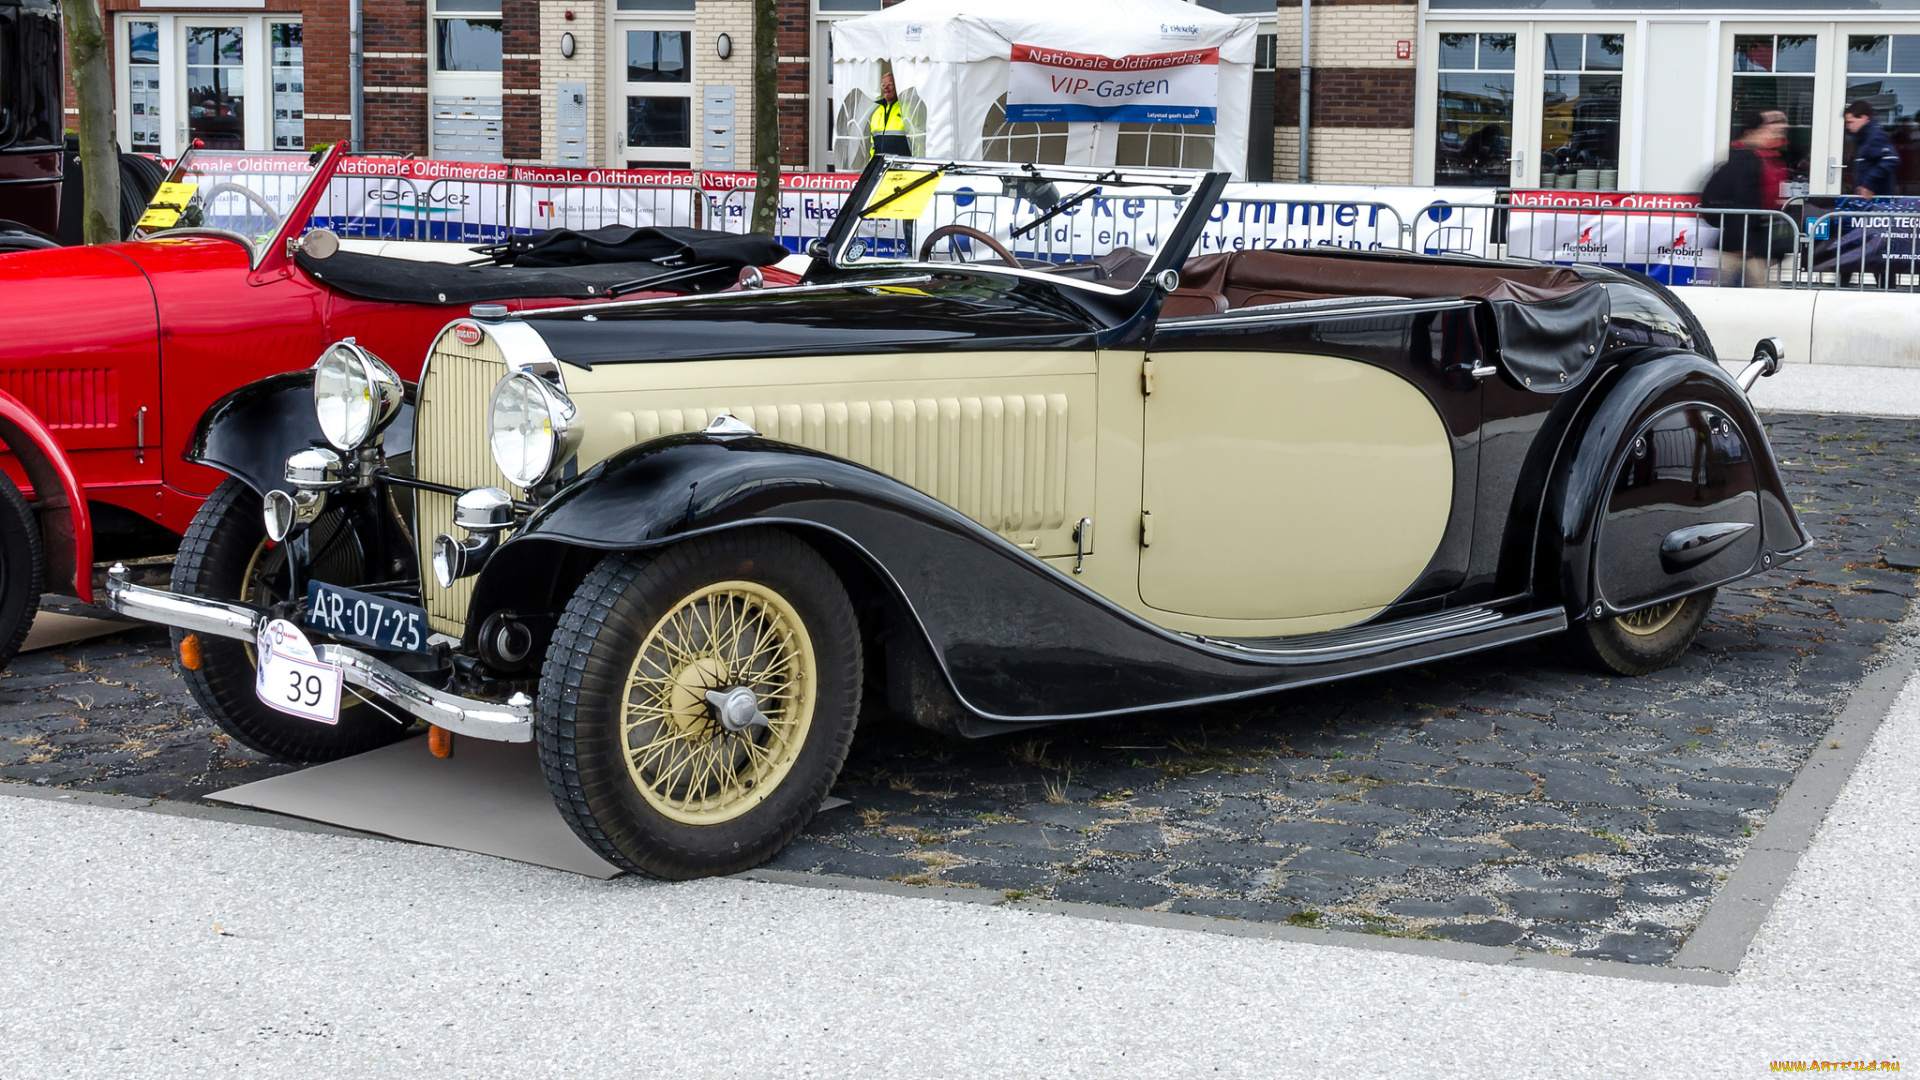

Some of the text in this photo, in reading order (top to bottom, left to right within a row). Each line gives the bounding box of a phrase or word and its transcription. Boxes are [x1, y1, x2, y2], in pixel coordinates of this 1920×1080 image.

[1029, 49, 1202, 70] Nationale Oldtimerdag
[1051, 75, 1169, 98] VIP-Gasten
[162, 160, 232, 171] Nonale
[336, 159, 506, 180] Nationale Oldtimerdag
[515, 167, 693, 186] Nationale Oldtimerdag
[702, 172, 786, 188] Natione
[1512, 193, 1613, 207] Nationale
[596, 206, 620, 214] Llystad
[1893, 217, 1920, 228] TEC
[1098, 231, 1129, 245] en
[456, 329, 477, 340] BUGATTI
[286, 670, 322, 706] 39
